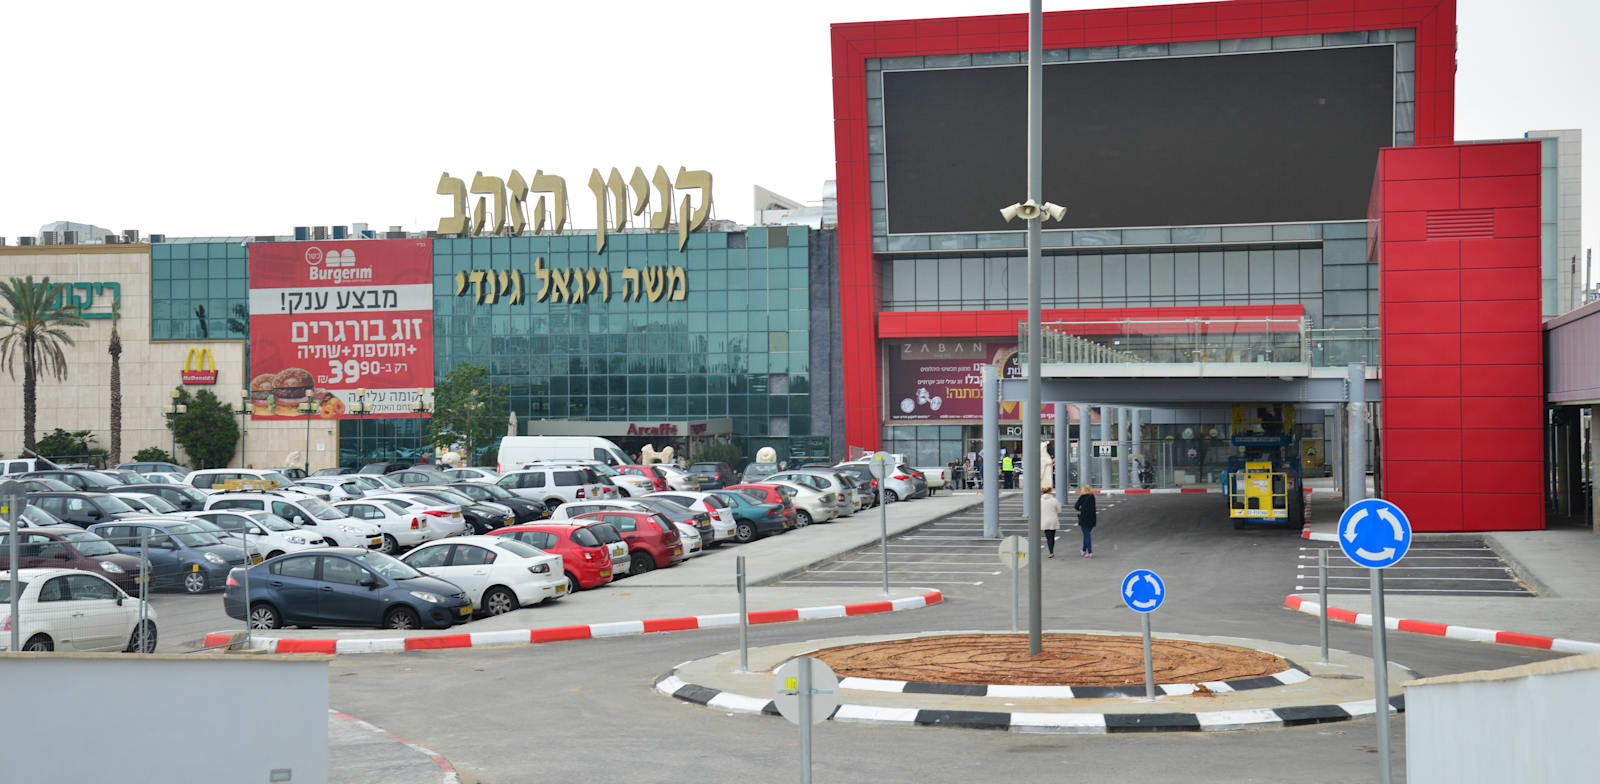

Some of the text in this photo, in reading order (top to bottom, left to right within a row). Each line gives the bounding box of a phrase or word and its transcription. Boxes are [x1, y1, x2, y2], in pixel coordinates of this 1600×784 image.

[436, 165, 713, 255] קניון הזהב
[309, 266, 372, 284] Burgerim
[455, 256, 687, 305] משה ויגאל גינדי
[15, 282, 120, 318] ריקו
[281, 290, 397, 315] מבצע ענק!
[291, 318, 422, 342] זוג בורגרים
[903, 343, 982, 353] ZABAN
[394, 363, 407, 374] רק
[390, 391, 419, 403] קומה
[1007, 427, 1024, 438] RO
